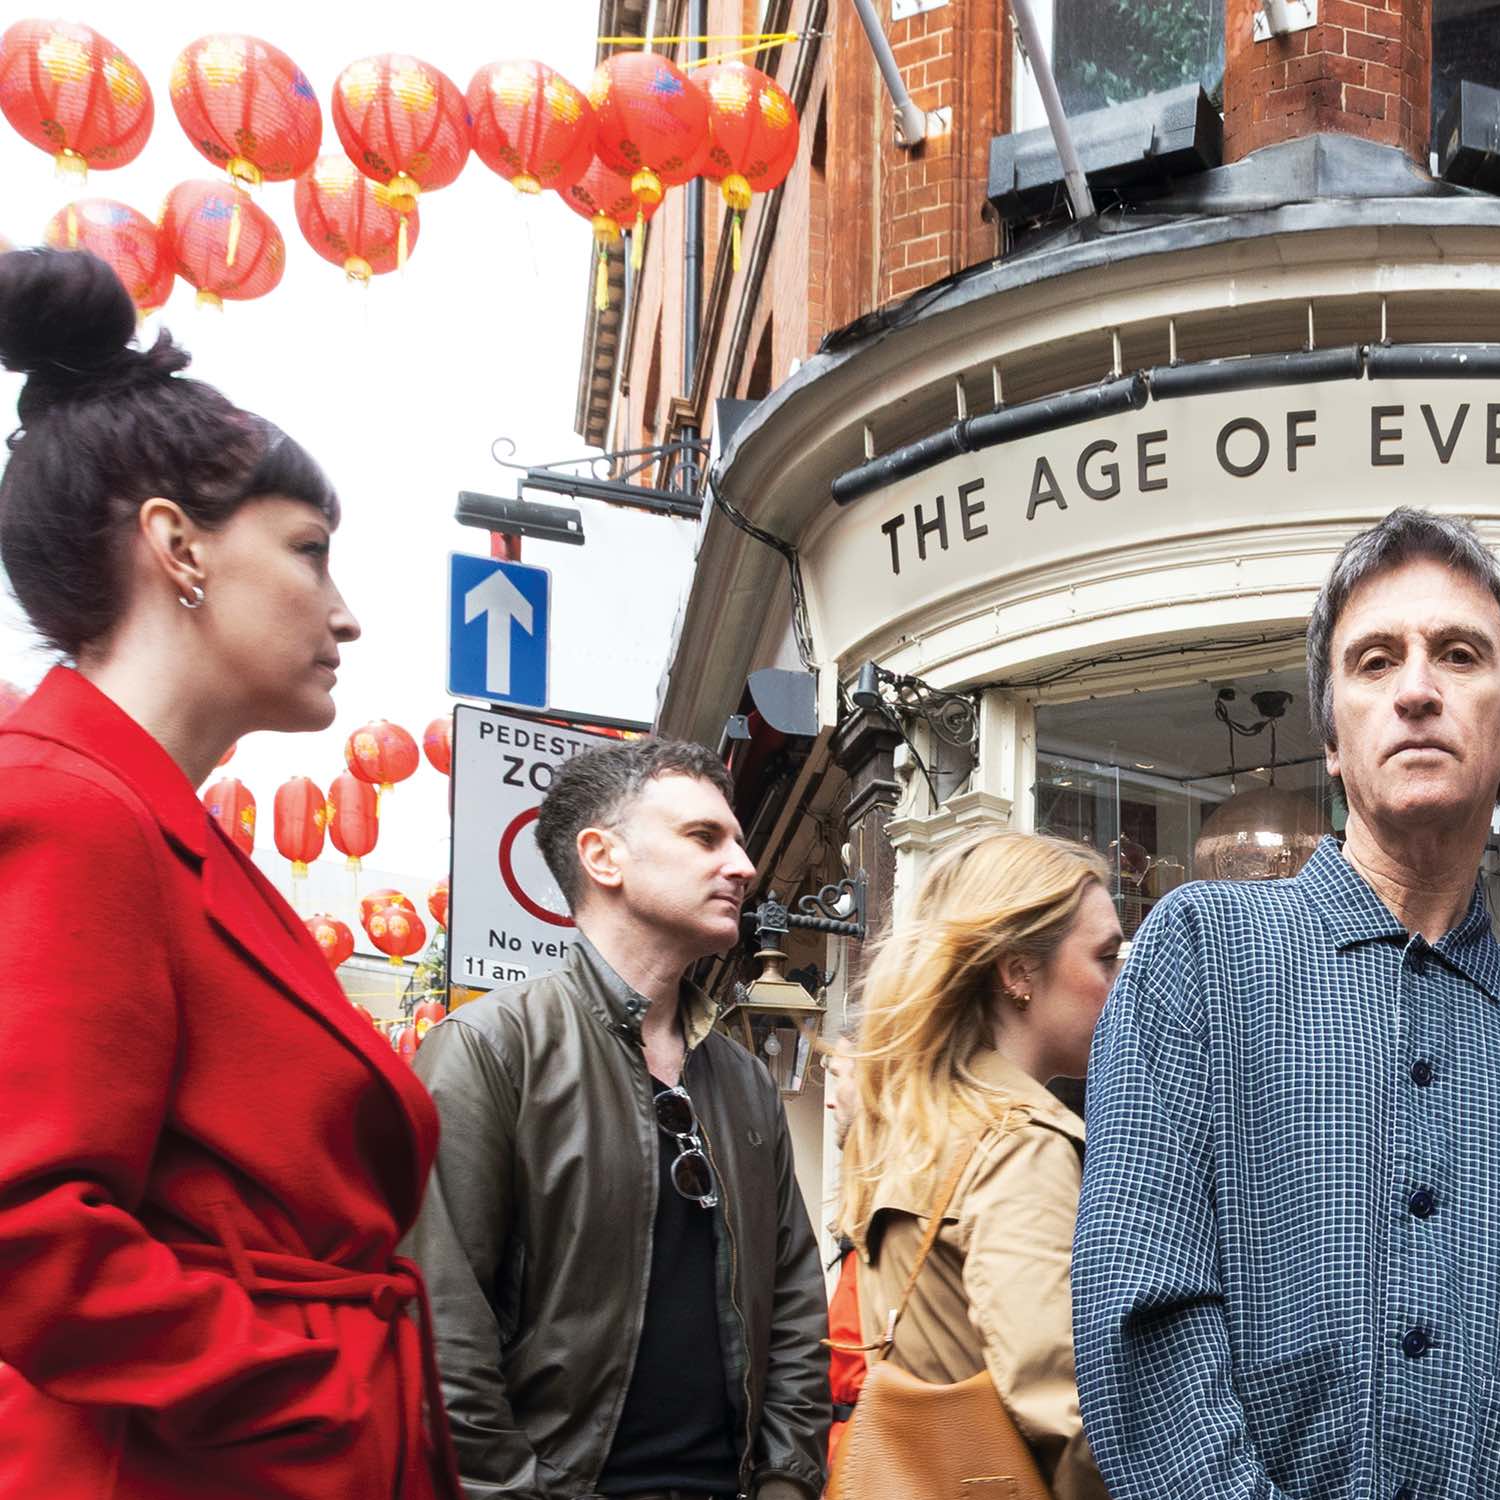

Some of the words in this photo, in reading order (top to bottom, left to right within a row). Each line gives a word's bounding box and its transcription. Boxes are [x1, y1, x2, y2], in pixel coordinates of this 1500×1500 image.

[881, 477, 988, 575] THE
[1026, 429, 1169, 520] AGE
[1216, 409, 1317, 478] OF
[480, 721, 592, 756] PEDEST
[503, 754, 556, 792] ZO
[489, 929, 522, 952] No
[532, 941, 569, 958] veh
